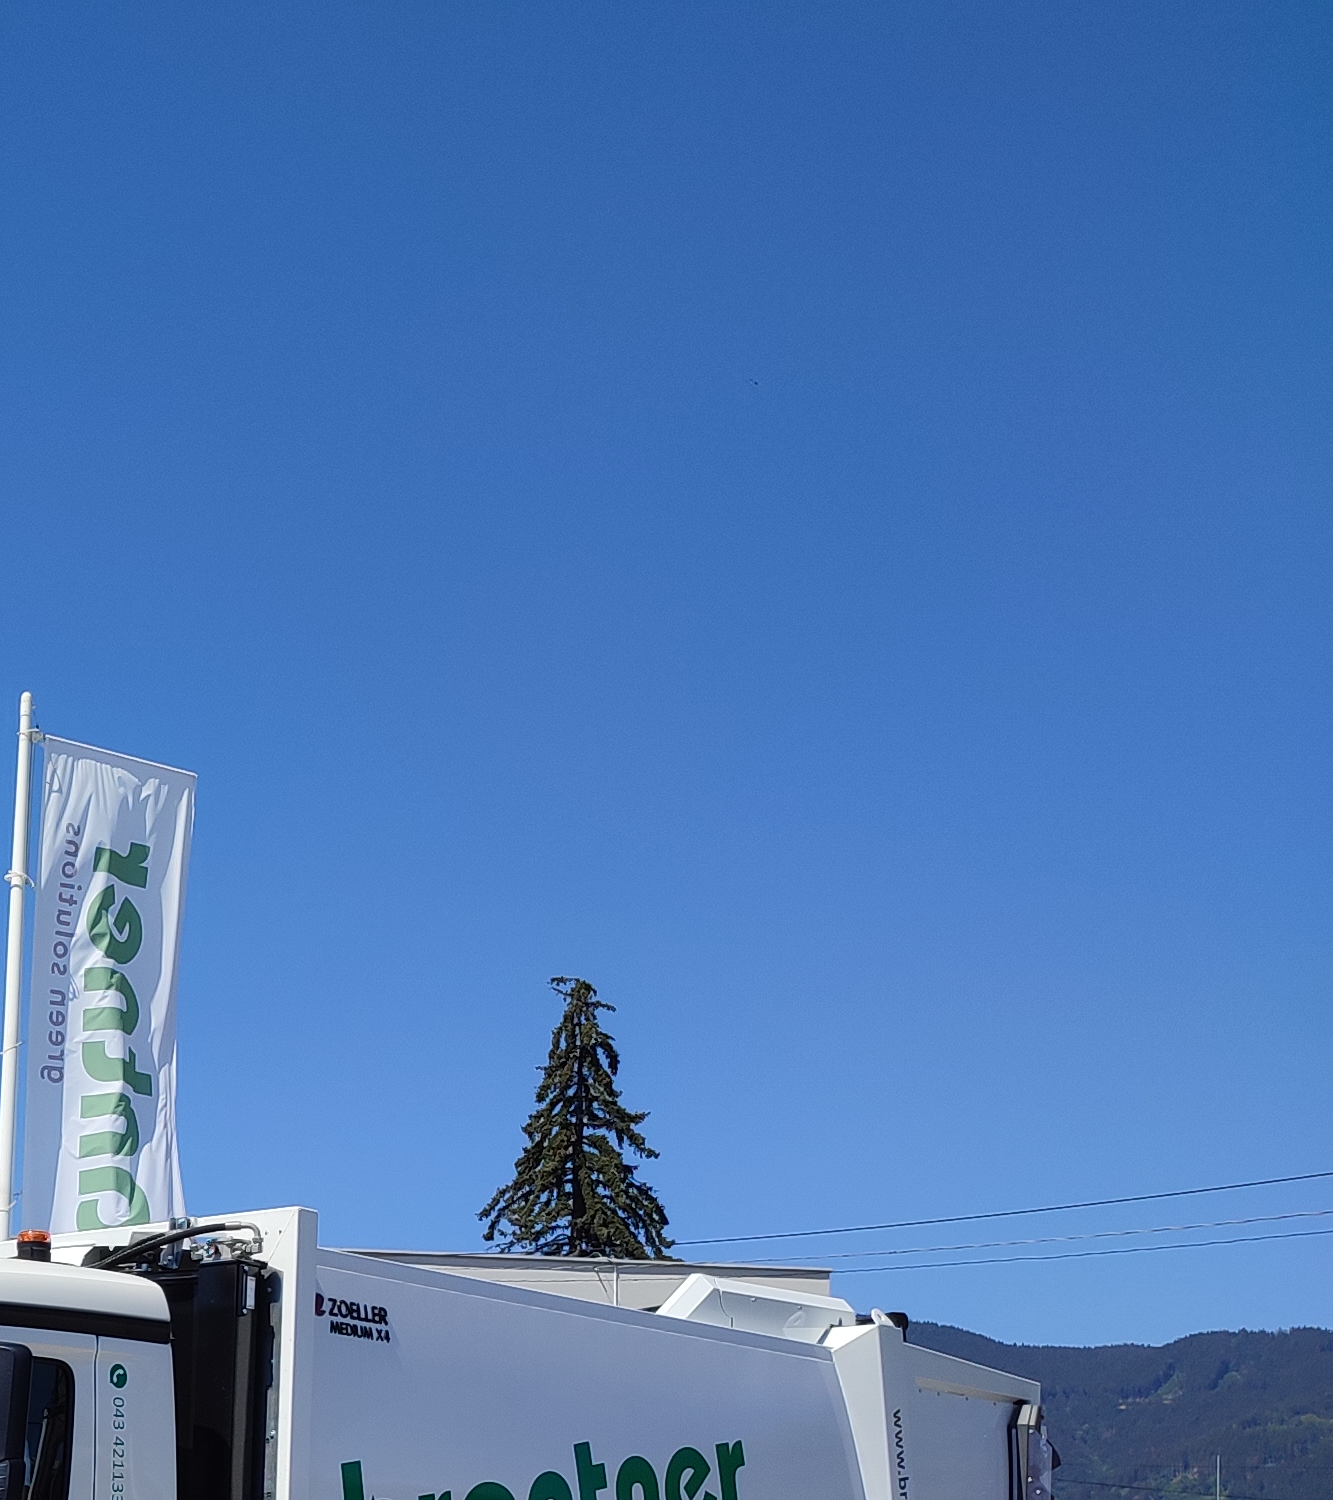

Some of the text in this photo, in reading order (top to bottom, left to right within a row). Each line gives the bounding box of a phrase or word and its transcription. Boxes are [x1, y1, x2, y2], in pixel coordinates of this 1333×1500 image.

[327, 1297, 389, 1327] ZOELLER
[329, 1319, 391, 1344] MEDIUM X4
[112, 1396, 125, 1431] 043
